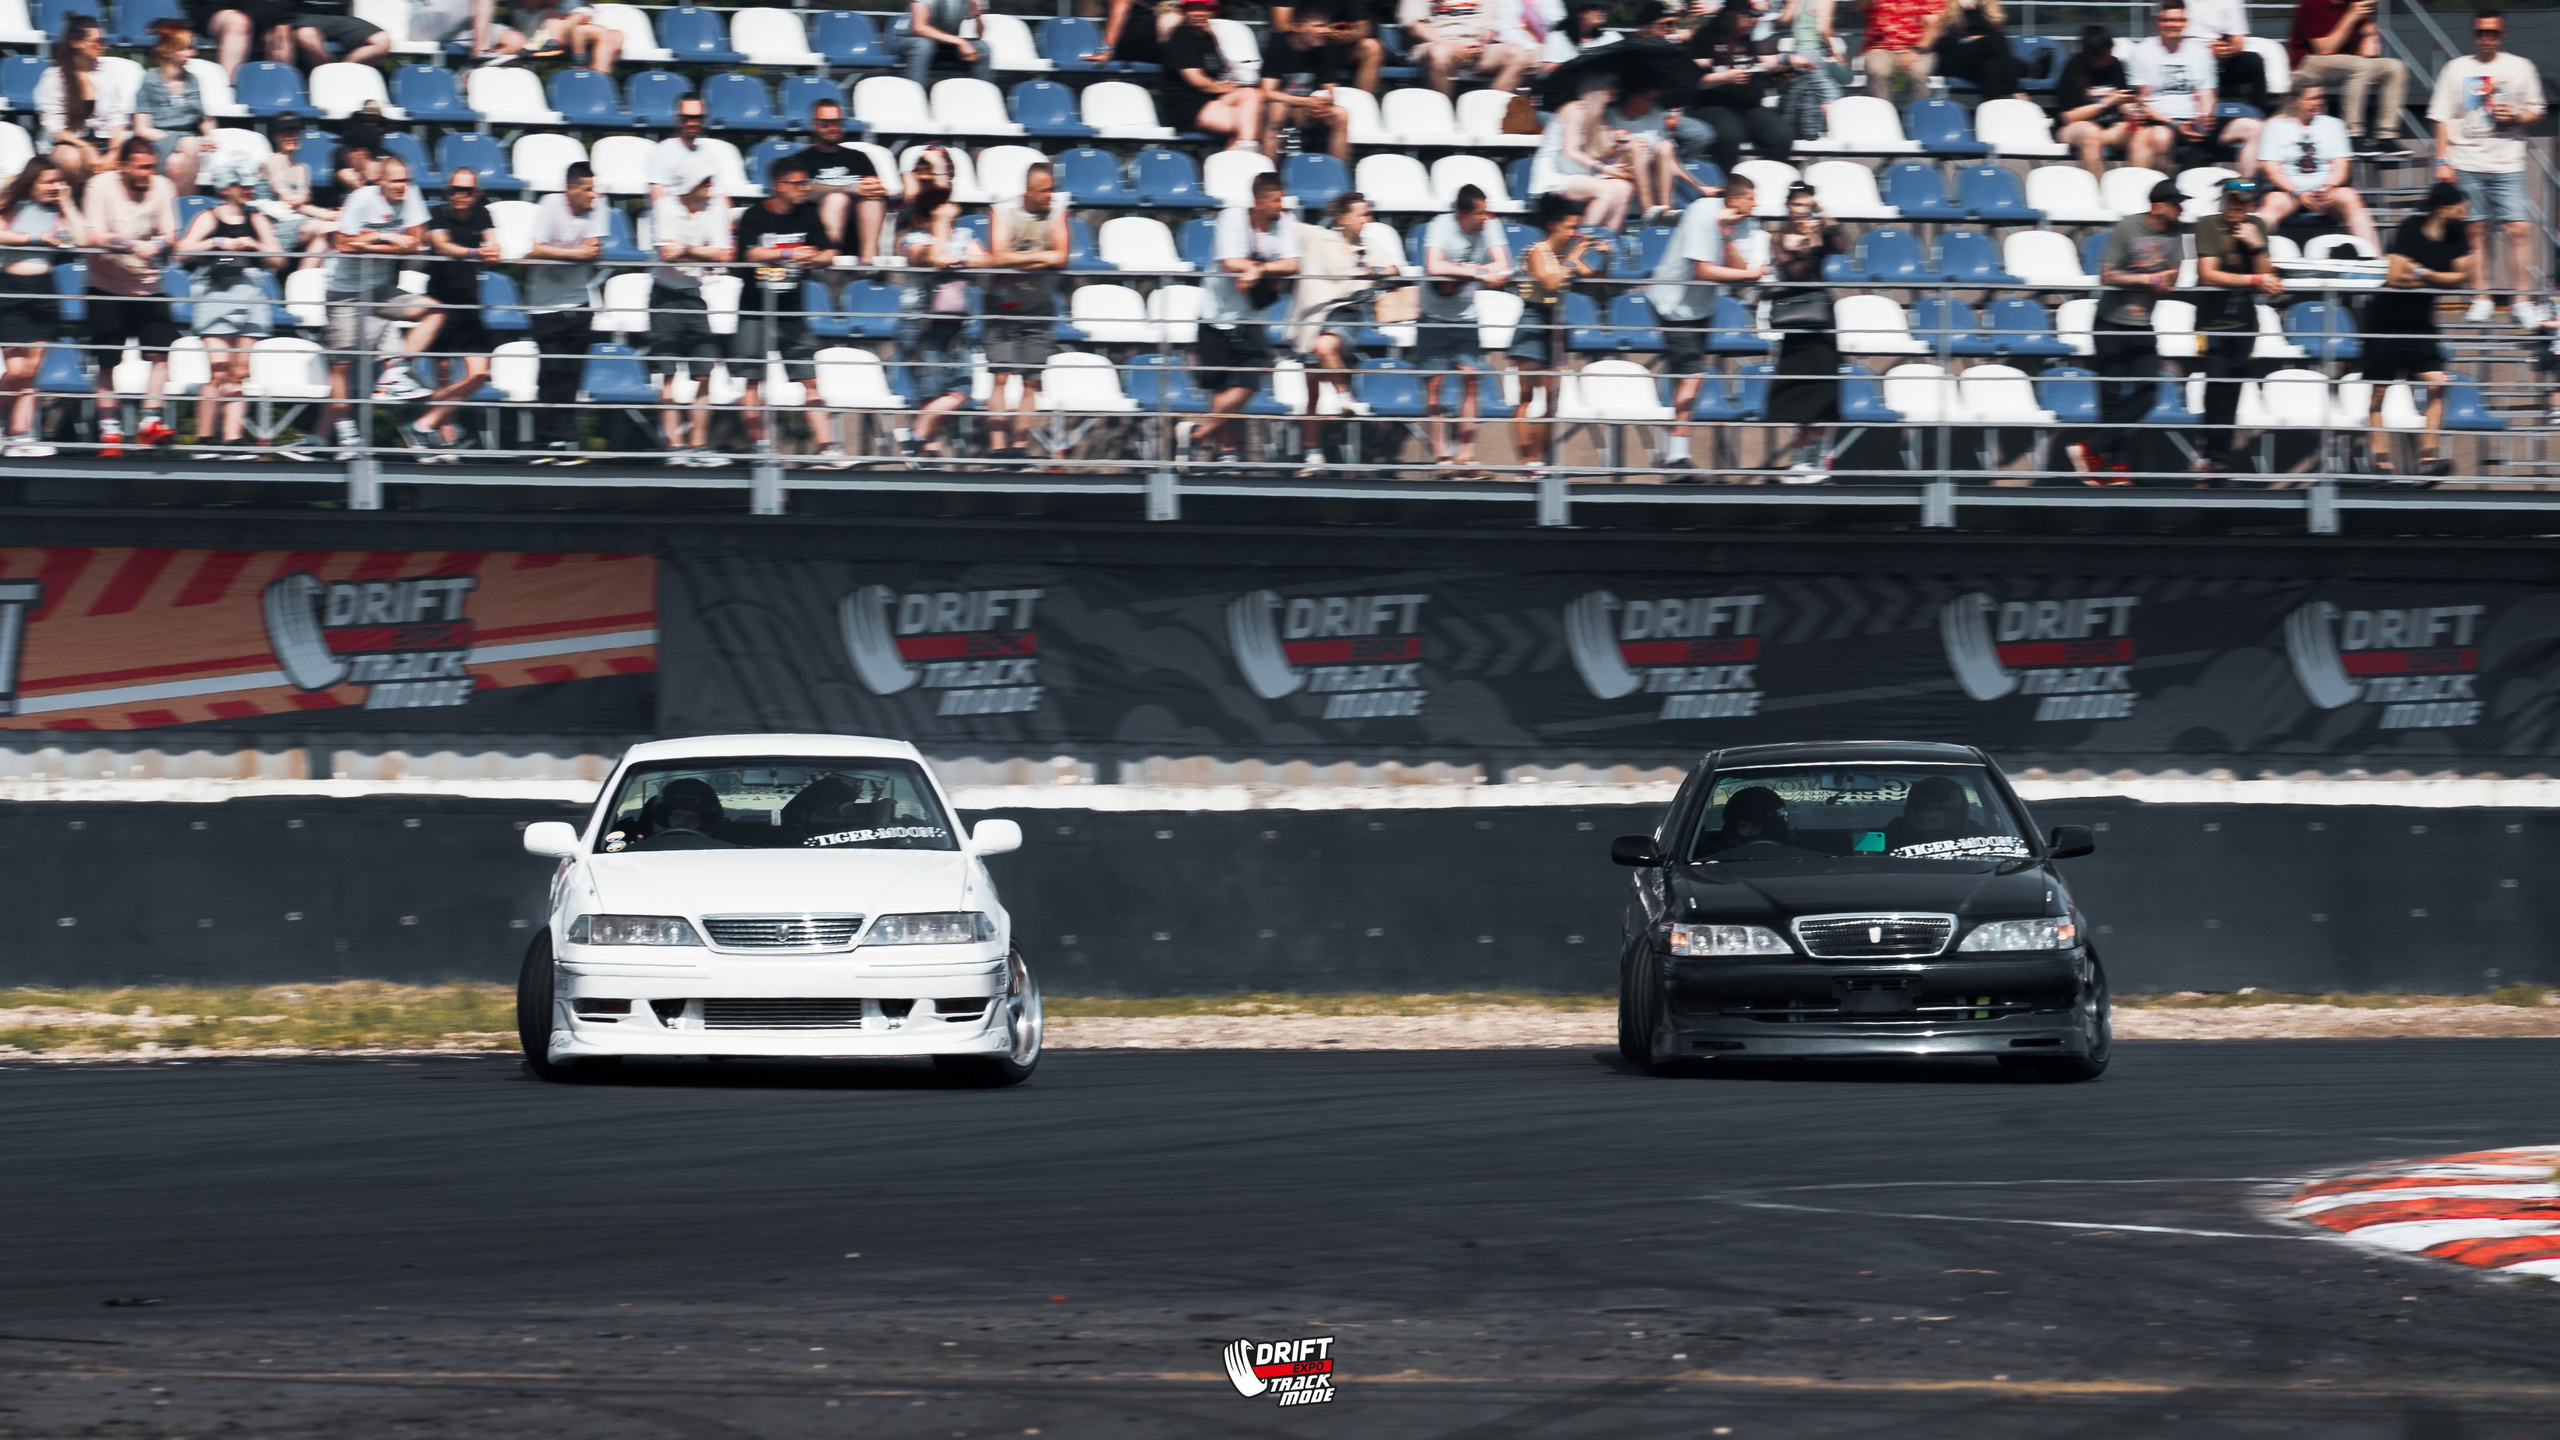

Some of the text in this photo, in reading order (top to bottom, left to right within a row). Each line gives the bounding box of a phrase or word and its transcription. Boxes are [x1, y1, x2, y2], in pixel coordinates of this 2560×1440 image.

[324, 578, 475, 625] DRIFT
[897, 589, 1045, 634] DRIFT
[1284, 594, 1431, 638] DRIFT
[1621, 595, 1765, 640] DRIFT
[1997, 597, 2141, 641] DRIFT
[2341, 605, 2486, 650] DRIFT
[350, 652, 470, 680] TRACK
[921, 659, 1039, 688] TRACK
[1308, 664, 1423, 692] TRACK
[1646, 665, 1758, 692] TRACK
[2020, 666, 2134, 694] TRACK
[2364, 675, 2479, 702] TRACK
